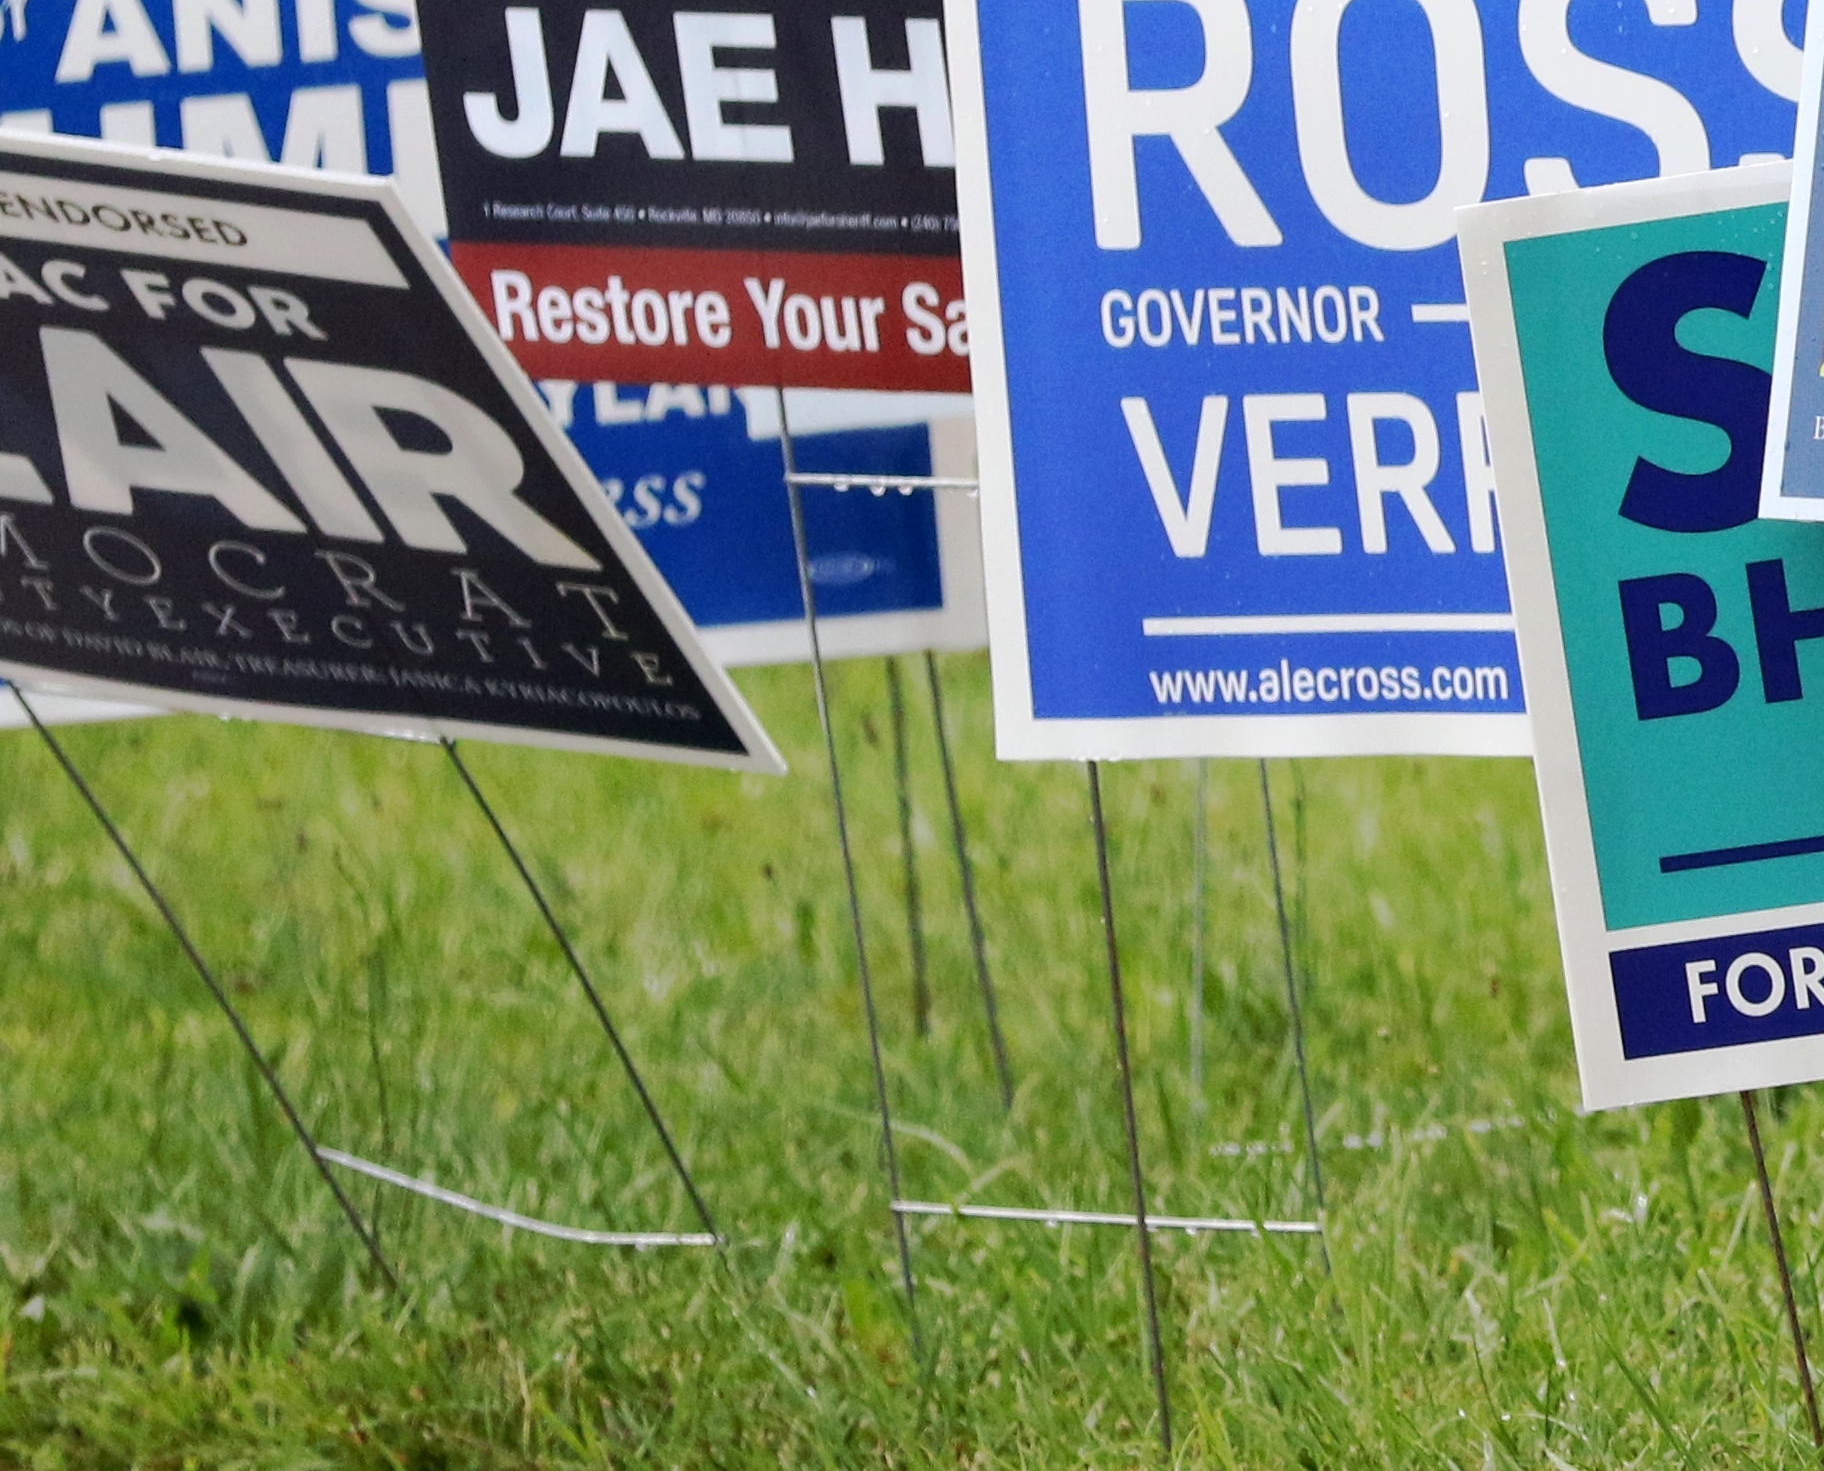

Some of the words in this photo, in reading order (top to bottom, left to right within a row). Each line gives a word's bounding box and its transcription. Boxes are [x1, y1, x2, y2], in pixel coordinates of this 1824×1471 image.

[462, 5, 794, 165] JAE
[830, 15, 956, 167] H
[0, 190, 249, 248] ENDORSED
[120, 268, 329, 342] FOR
[490, 270, 732, 350] Restore
[745, 277, 886, 356] Your
[1101, 285, 1385, 349] GOVERNOR
[1149, 660, 1509, 704] www.alecross.com
